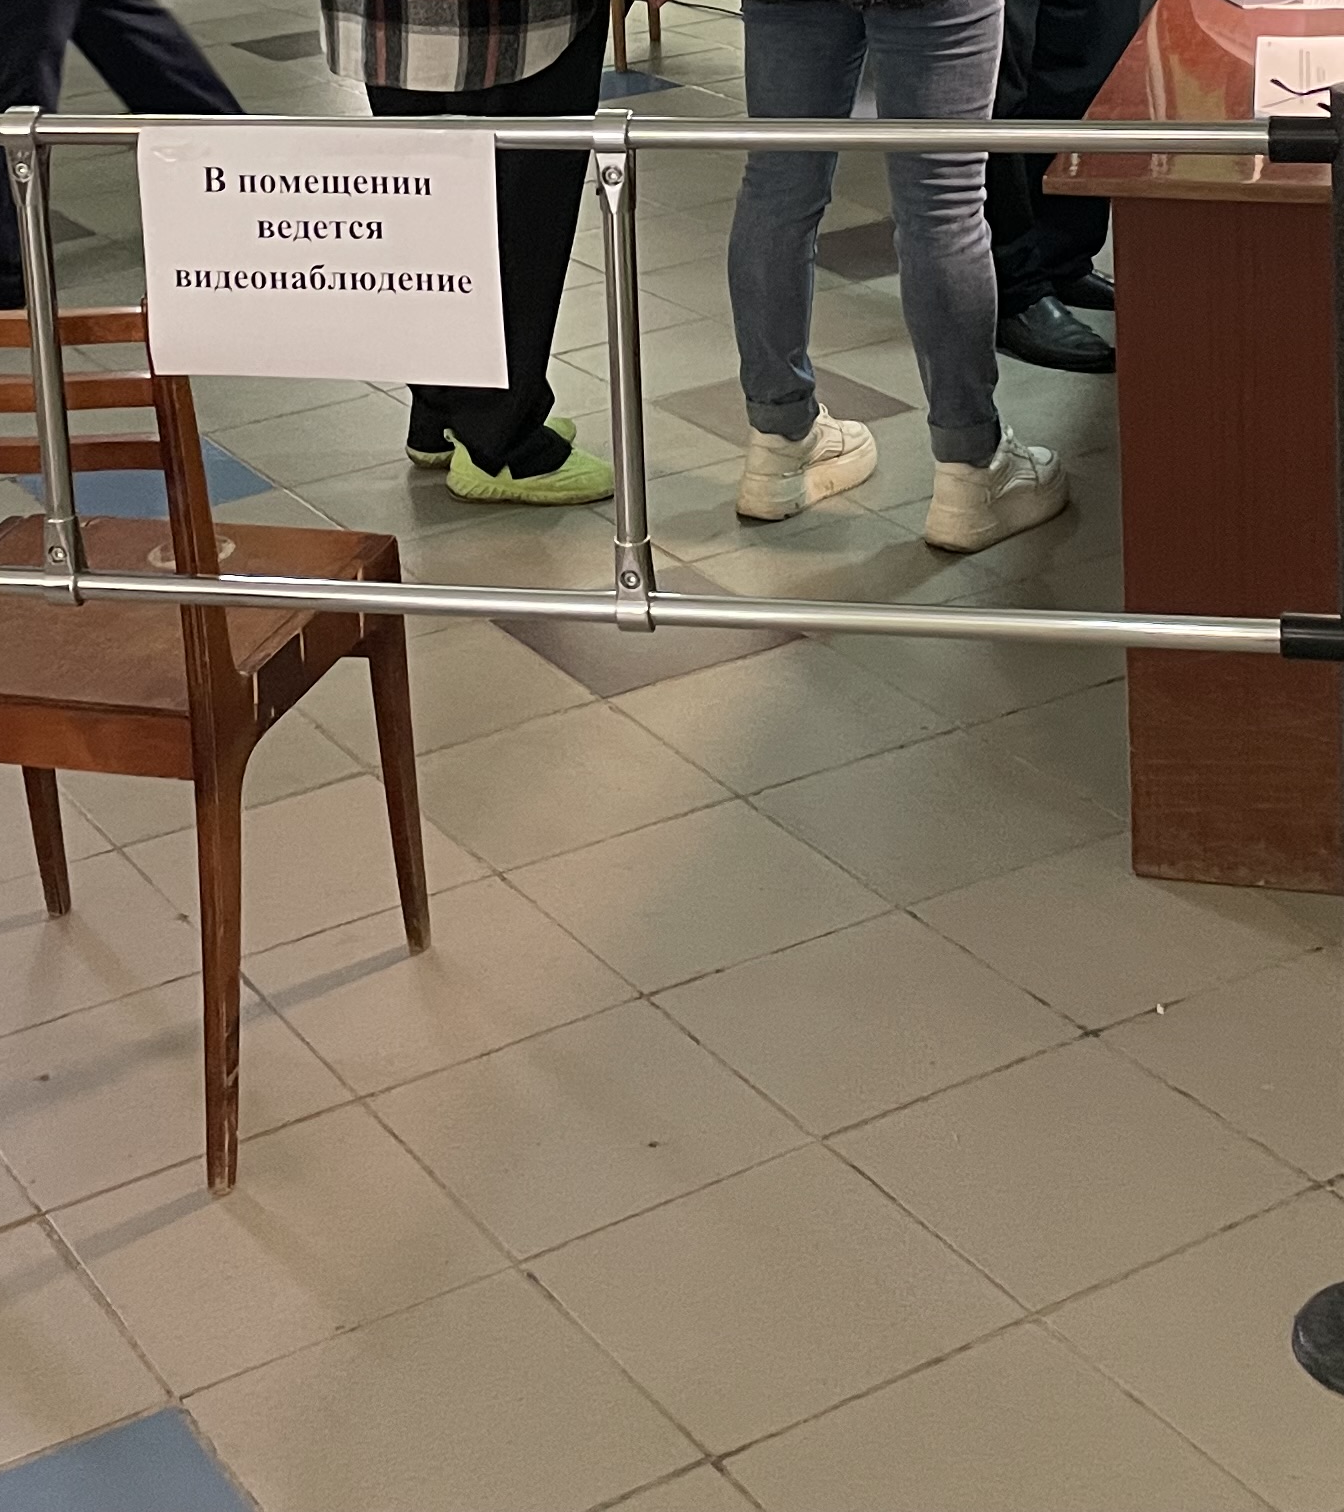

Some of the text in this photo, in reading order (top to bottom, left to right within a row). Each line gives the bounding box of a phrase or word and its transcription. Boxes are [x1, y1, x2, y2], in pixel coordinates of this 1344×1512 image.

[203, 166, 432, 197] В помещении
[257, 219, 383, 242] ведется
[175, 264, 473, 294] видеонаблюдение
